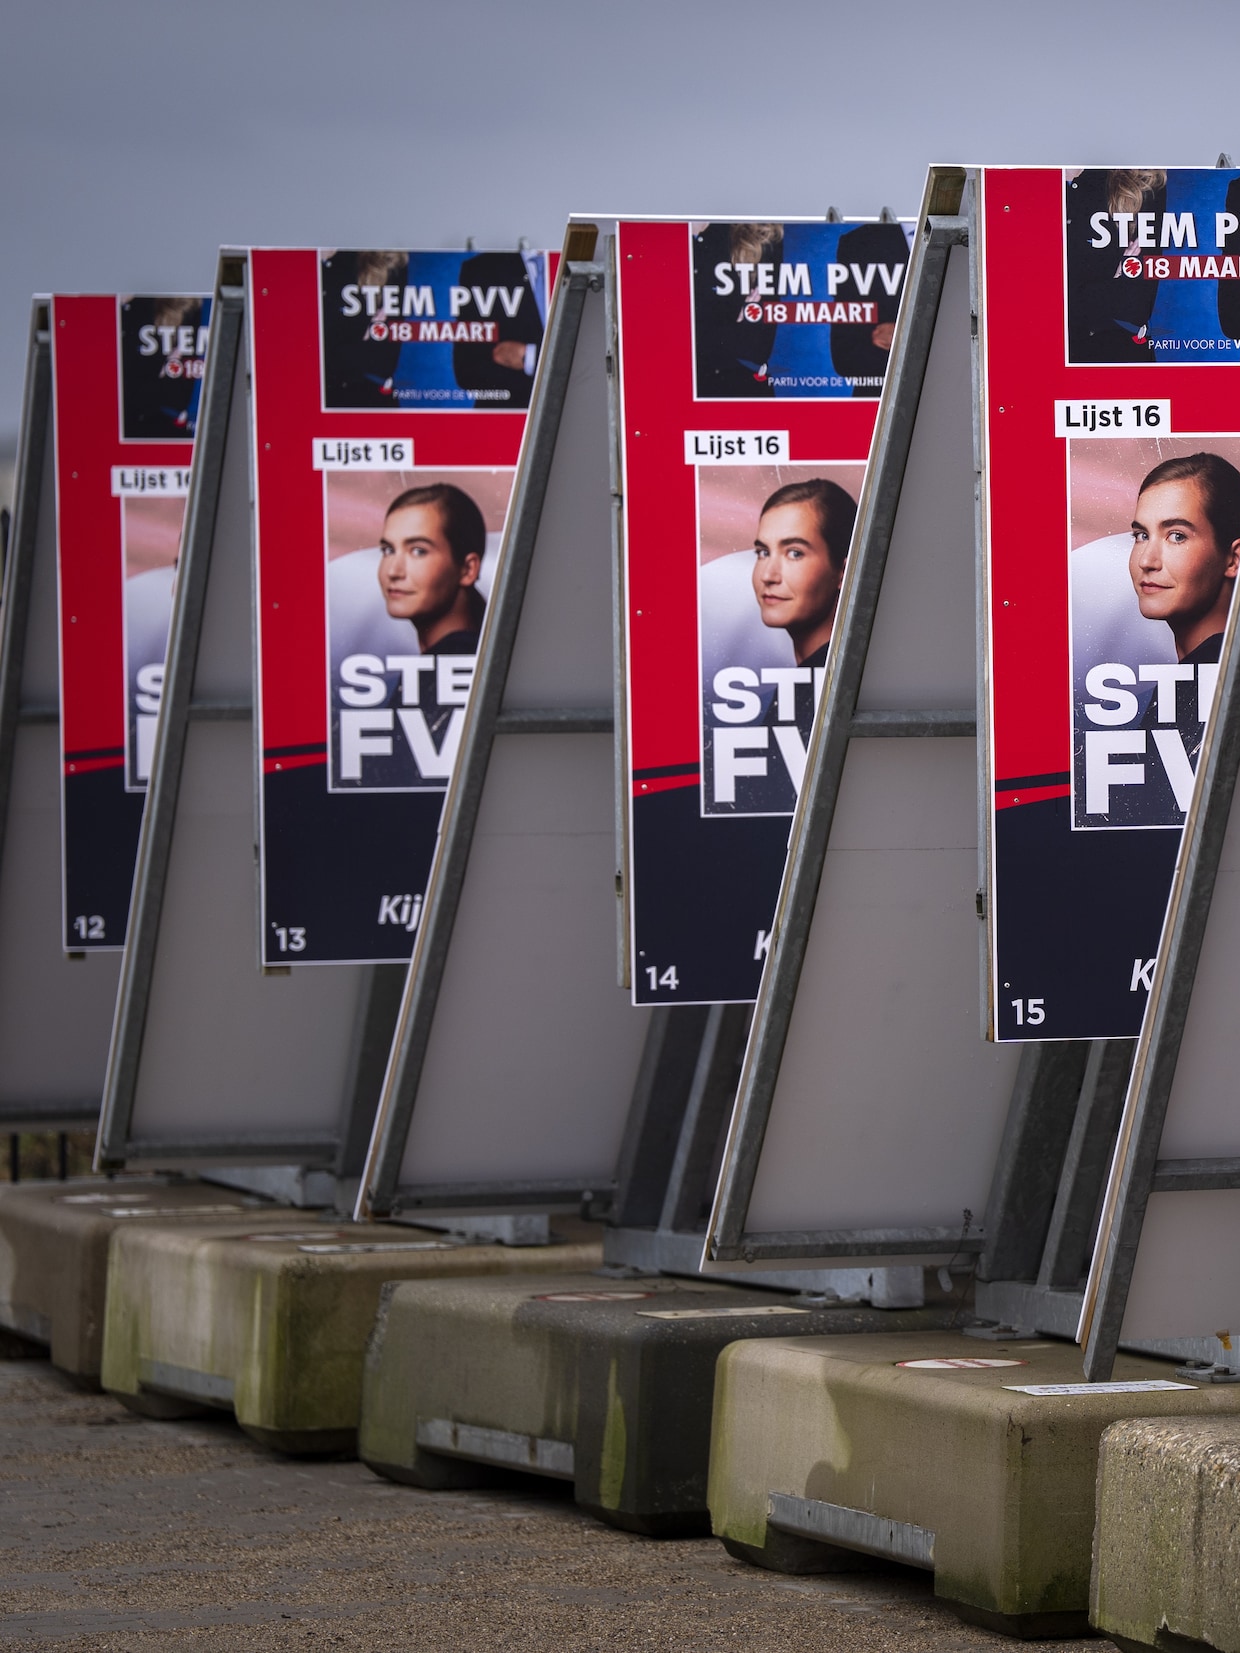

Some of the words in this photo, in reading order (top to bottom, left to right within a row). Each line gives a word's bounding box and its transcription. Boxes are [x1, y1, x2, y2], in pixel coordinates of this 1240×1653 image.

[1089, 211, 1198, 249] STEM
[713, 261, 812, 297] STEM
[827, 263, 905, 296] PVV
[1145, 257, 1170, 279] 18
[341, 284, 436, 317] STEM
[449, 285, 525, 317] PVV
[764, 303, 788, 323] 18
[795, 302, 875, 323] MAART
[389, 321, 413, 341] 18
[418, 321, 496, 342] MAART
[1148, 340, 1181, 350] PARTIJ
[1183, 340, 1216, 350] VOOR
[1218, 340, 1231, 349] DE
[183, 360, 204, 379] 18
[768, 376, 797, 387] PARTIJ
[799, 376, 829, 387] VOOR
[830, 376, 843, 387] DE
[845, 376, 885, 386] VRIJHEI
[1065, 405, 1123, 431] Lijst
[1131, 405, 1161, 427] 16
[322, 442, 372, 465] Lijst
[380, 443, 404, 461] 16
[694, 435, 746, 459] Lijst
[754, 436, 780, 456] 16
[120, 471, 166, 492] Lijst
[339, 653, 477, 708] STE
[712, 666, 826, 724] ST
[378, 893, 423, 932] Kij
[77, 915, 105, 939] 12
[275, 927, 307, 951] 13
[645, 965, 680, 991] 14
[1011, 998, 1046, 1026] 15
